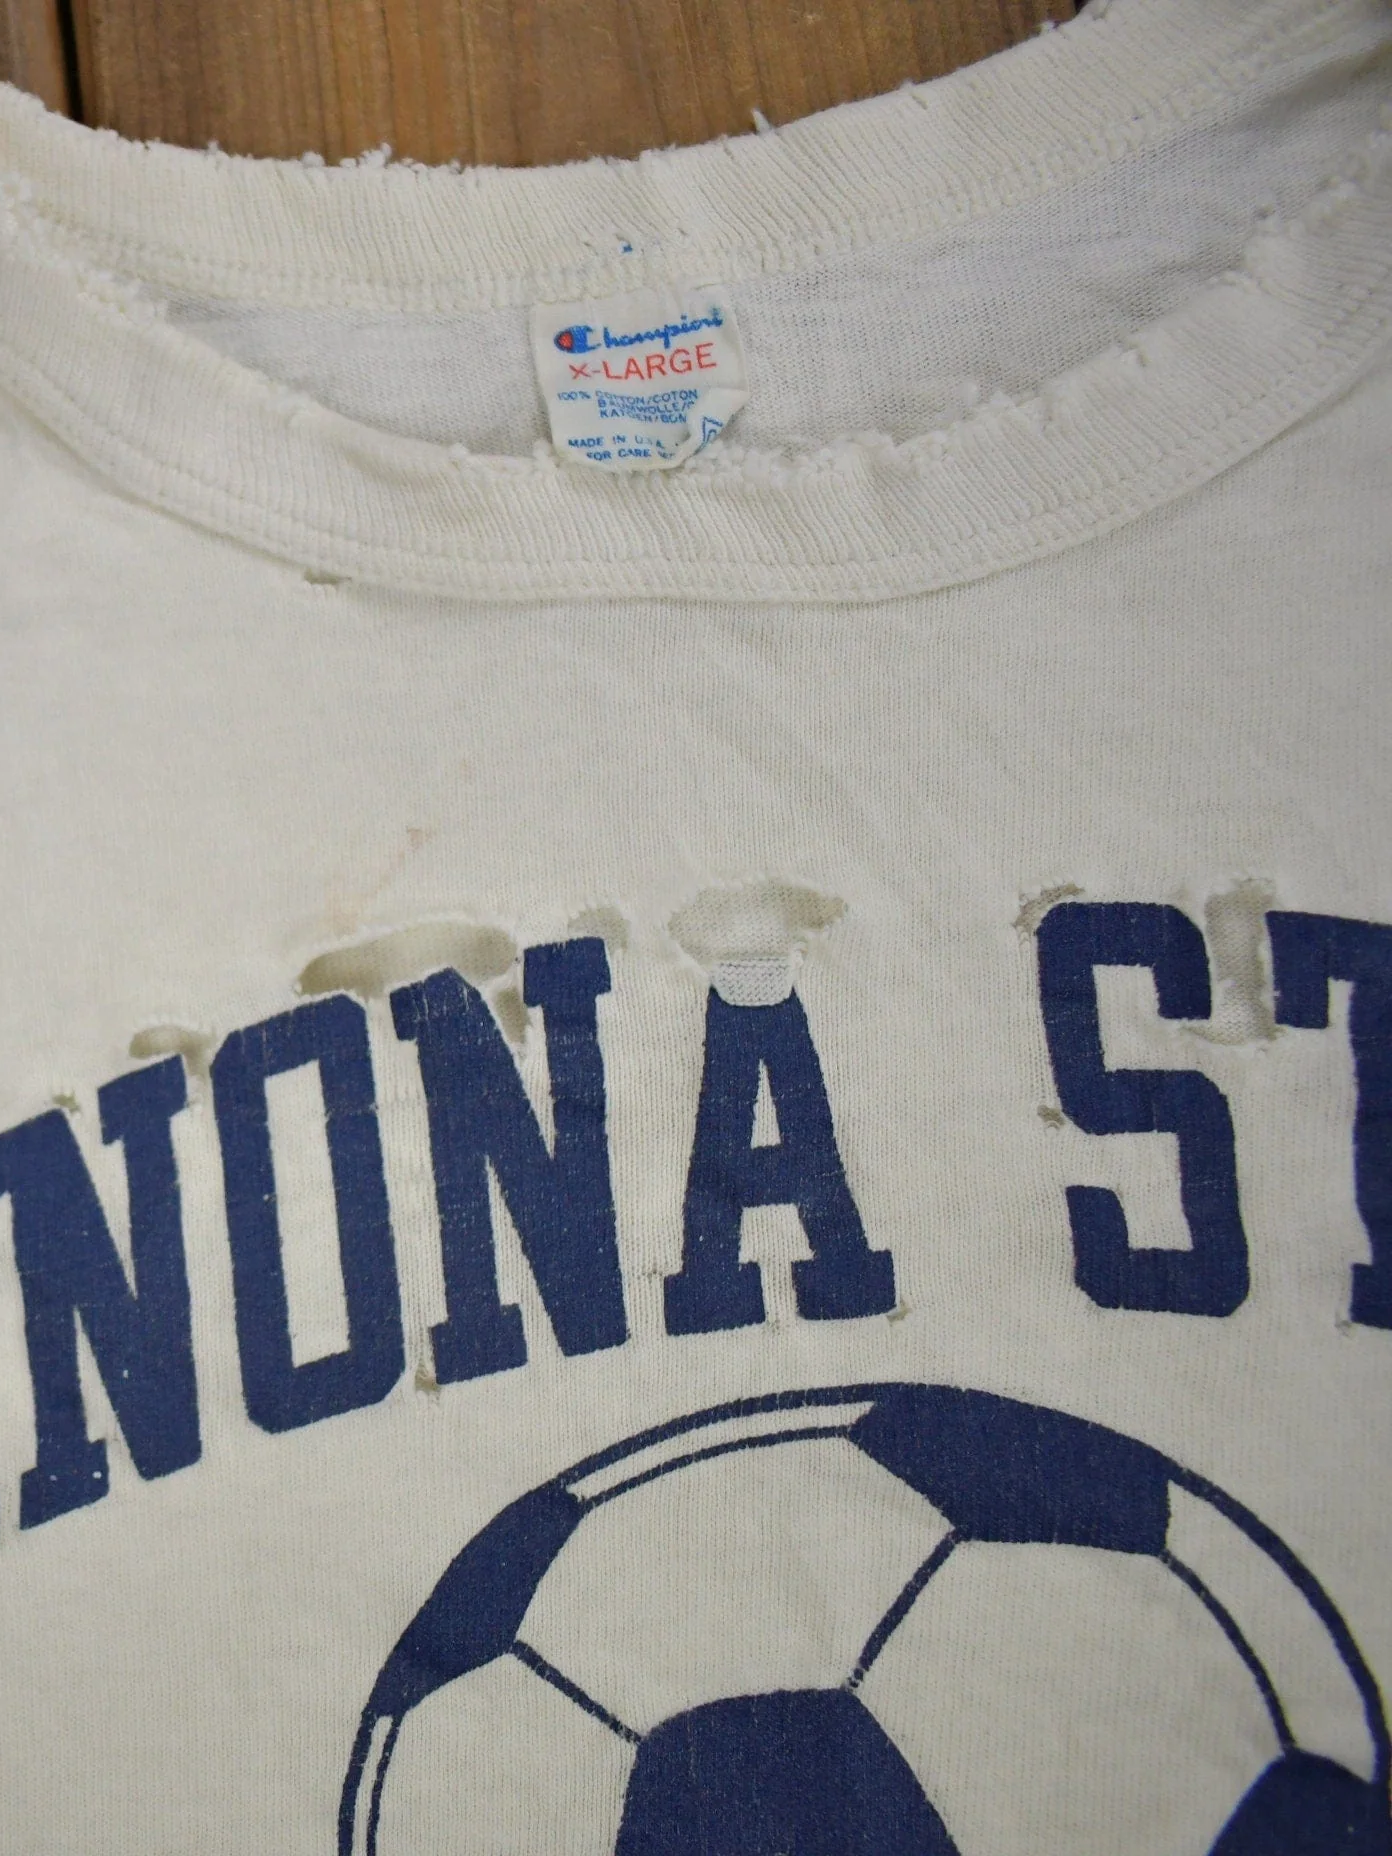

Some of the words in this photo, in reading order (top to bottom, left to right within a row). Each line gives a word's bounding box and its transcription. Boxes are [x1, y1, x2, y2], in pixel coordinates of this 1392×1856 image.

[554, 308, 724, 353] Champion
[568, 342, 717, 380] X-LARGE
[557, 391, 591, 401] 100%
[567, 436, 604, 448] MADE
[612, 434, 626, 444] IN
[586, 450, 612, 461] FOR
[617, 448, 651, 458] CARE
